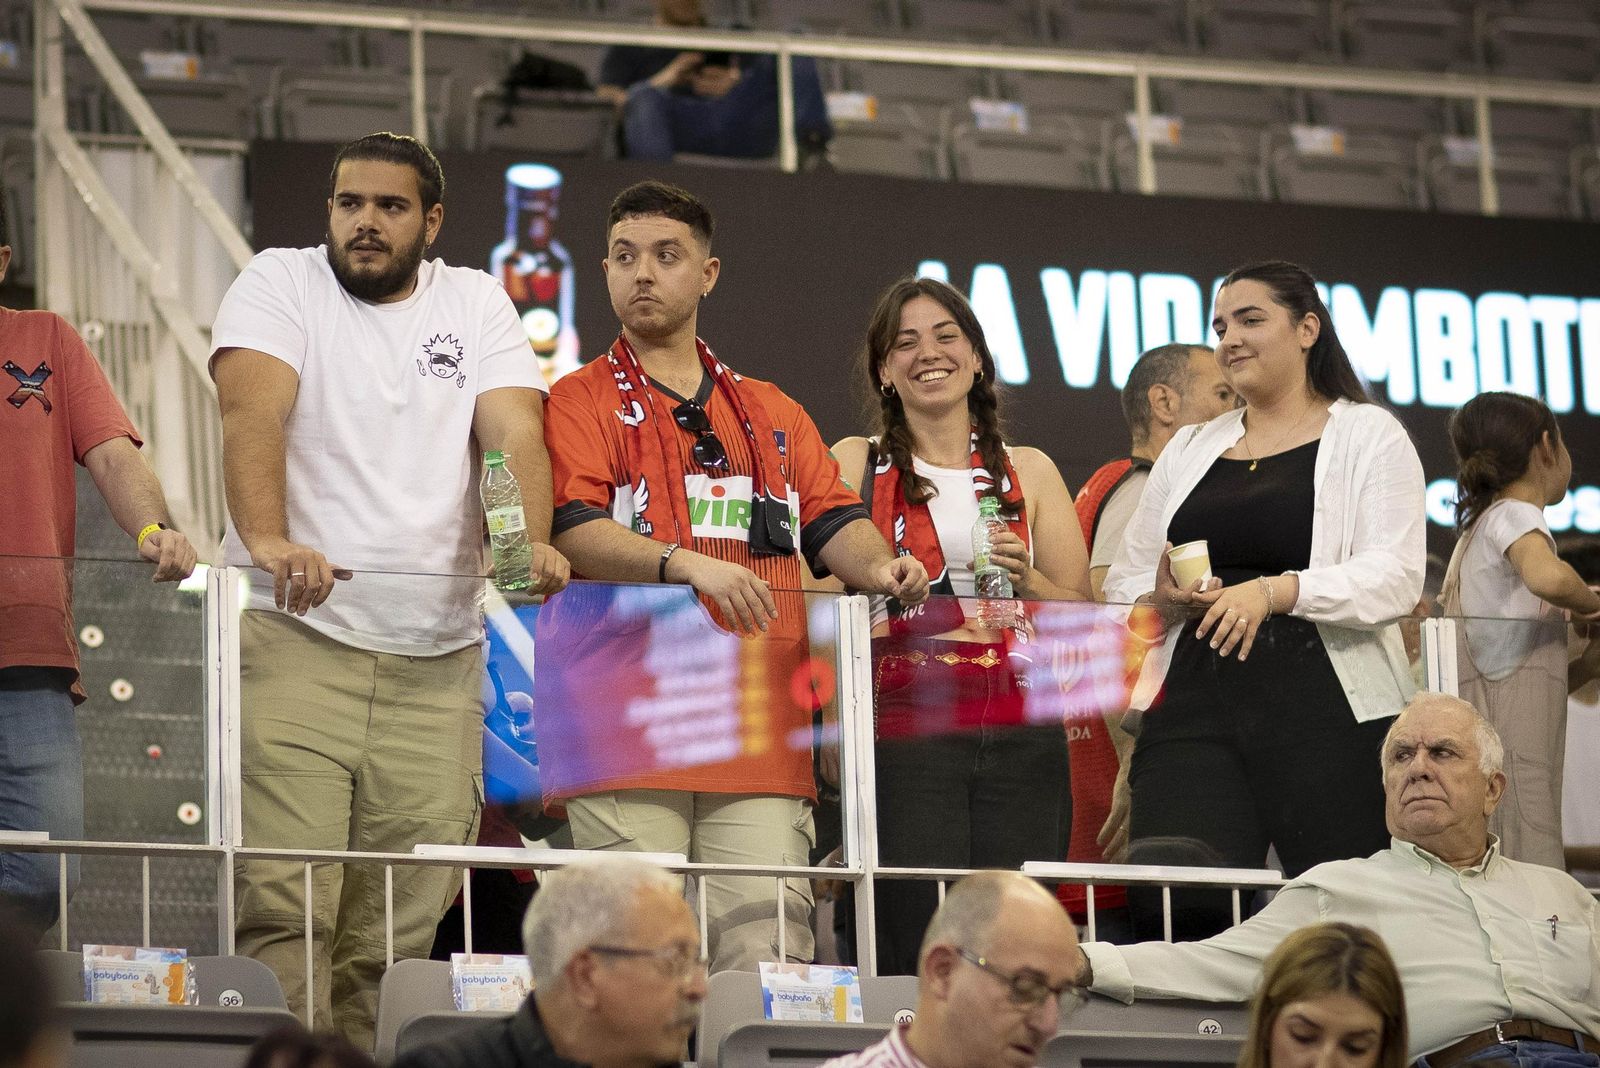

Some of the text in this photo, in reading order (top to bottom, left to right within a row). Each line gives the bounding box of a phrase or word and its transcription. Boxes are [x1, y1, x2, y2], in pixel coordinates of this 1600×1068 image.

[1039, 266, 1228, 390] VID
[1315, 282, 1600, 416] MBOT
[93, 970, 140, 982] babybaño
[461, 975, 508, 986] babybaño
[222, 995, 239, 1007] 36
[1203, 1024, 1219, 1035] 42
